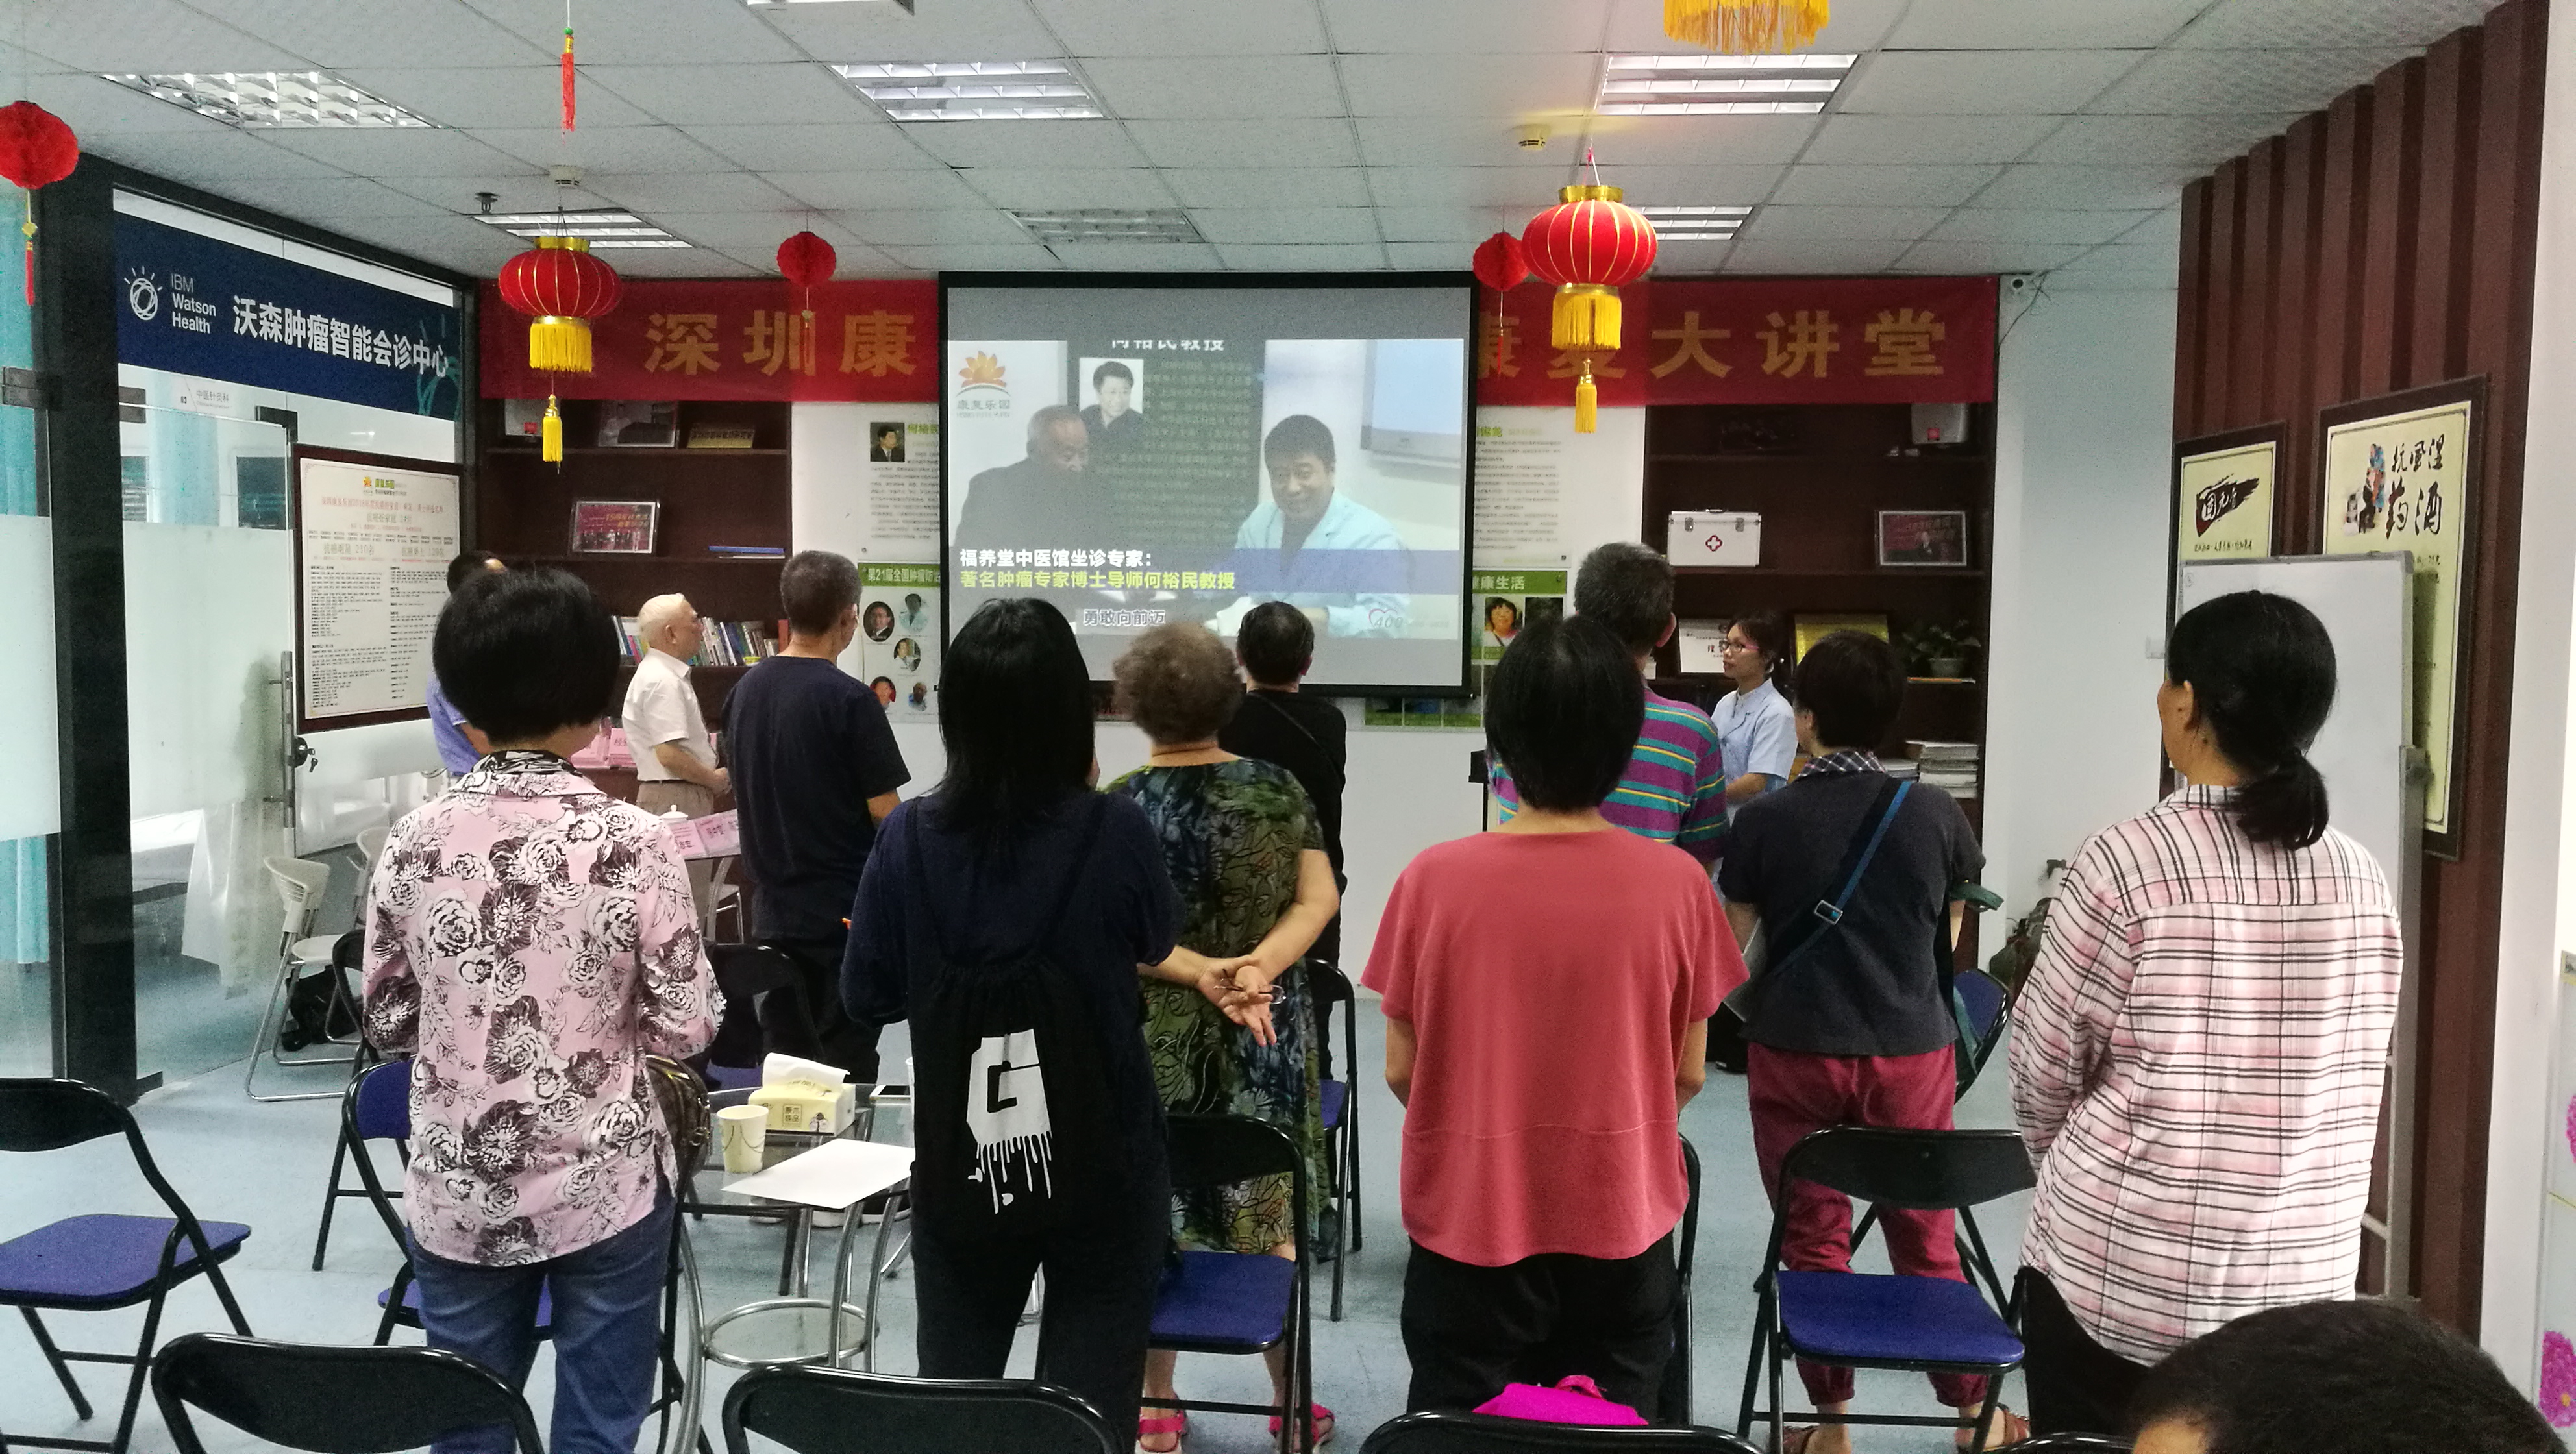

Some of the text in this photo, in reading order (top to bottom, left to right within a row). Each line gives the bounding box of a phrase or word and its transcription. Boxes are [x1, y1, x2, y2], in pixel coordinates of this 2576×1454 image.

[171, 273, 193, 293] IBM
[172, 293, 217, 317] Watson
[172, 311, 211, 334] Health
[232, 294, 450, 378] 沃森肿瘤智能会诊中心
[644, 309, 917, 377] 深圳康
[960, 571, 1235, 590] 著名肿瘤专家博士导师何裕民教授
[1084, 609, 1166, 627] 勇敢向前迈
